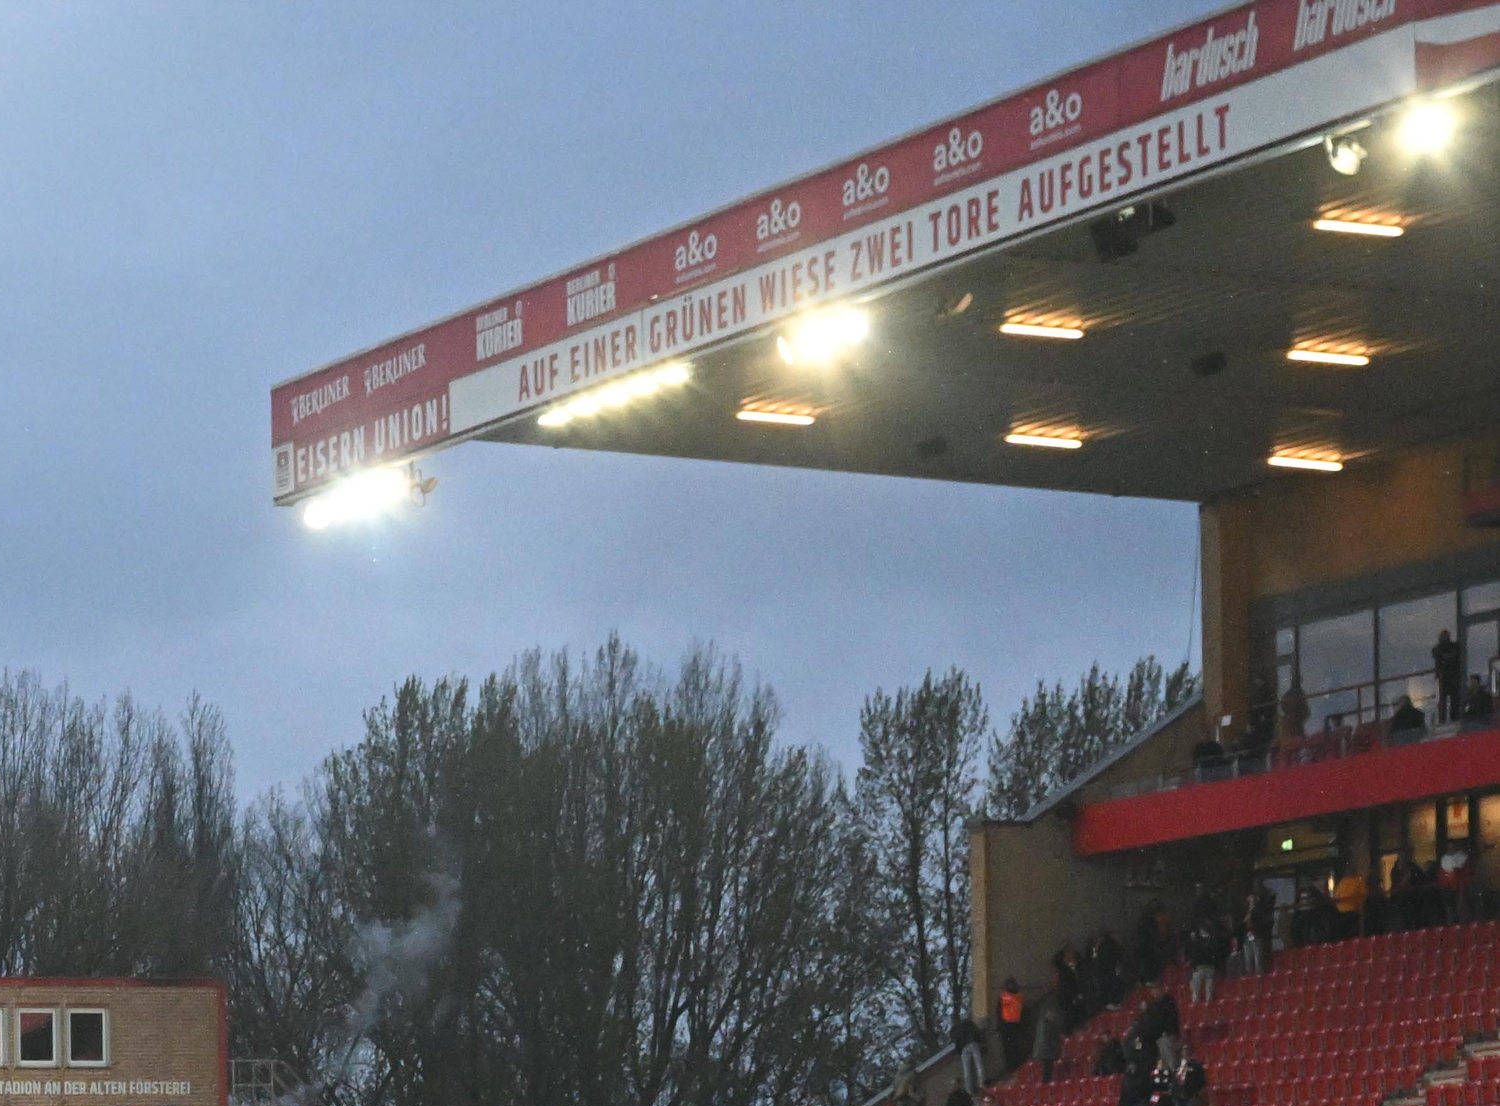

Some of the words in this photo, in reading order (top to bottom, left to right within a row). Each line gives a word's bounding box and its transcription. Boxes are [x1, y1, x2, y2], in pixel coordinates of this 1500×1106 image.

[1161, 11, 1259, 102] bardusch
[1030, 89, 1082, 135] a&o
[933, 127, 984, 172] a&o
[842, 163, 890, 206] a&o
[756, 198, 801, 240] a&o
[518, 353, 559, 402] AUF
[569, 324, 637, 383] EINER
[648, 283, 747, 353] GRÜNEN
[759, 250, 835, 314] WIESE
[851, 221, 914, 282] ZWEI
[928, 189, 999, 252] TORE
[1018, 102, 1232, 222] AUFGESTELLT
[674, 230, 717, 272] a&o
[296, 425, 365, 483] EISERN
[374, 394, 448, 453] UNION!
[45, 1081, 60, 1095] AN
[63, 1081, 86, 1095] DER
[90, 1081, 126, 1095] ALTEN
